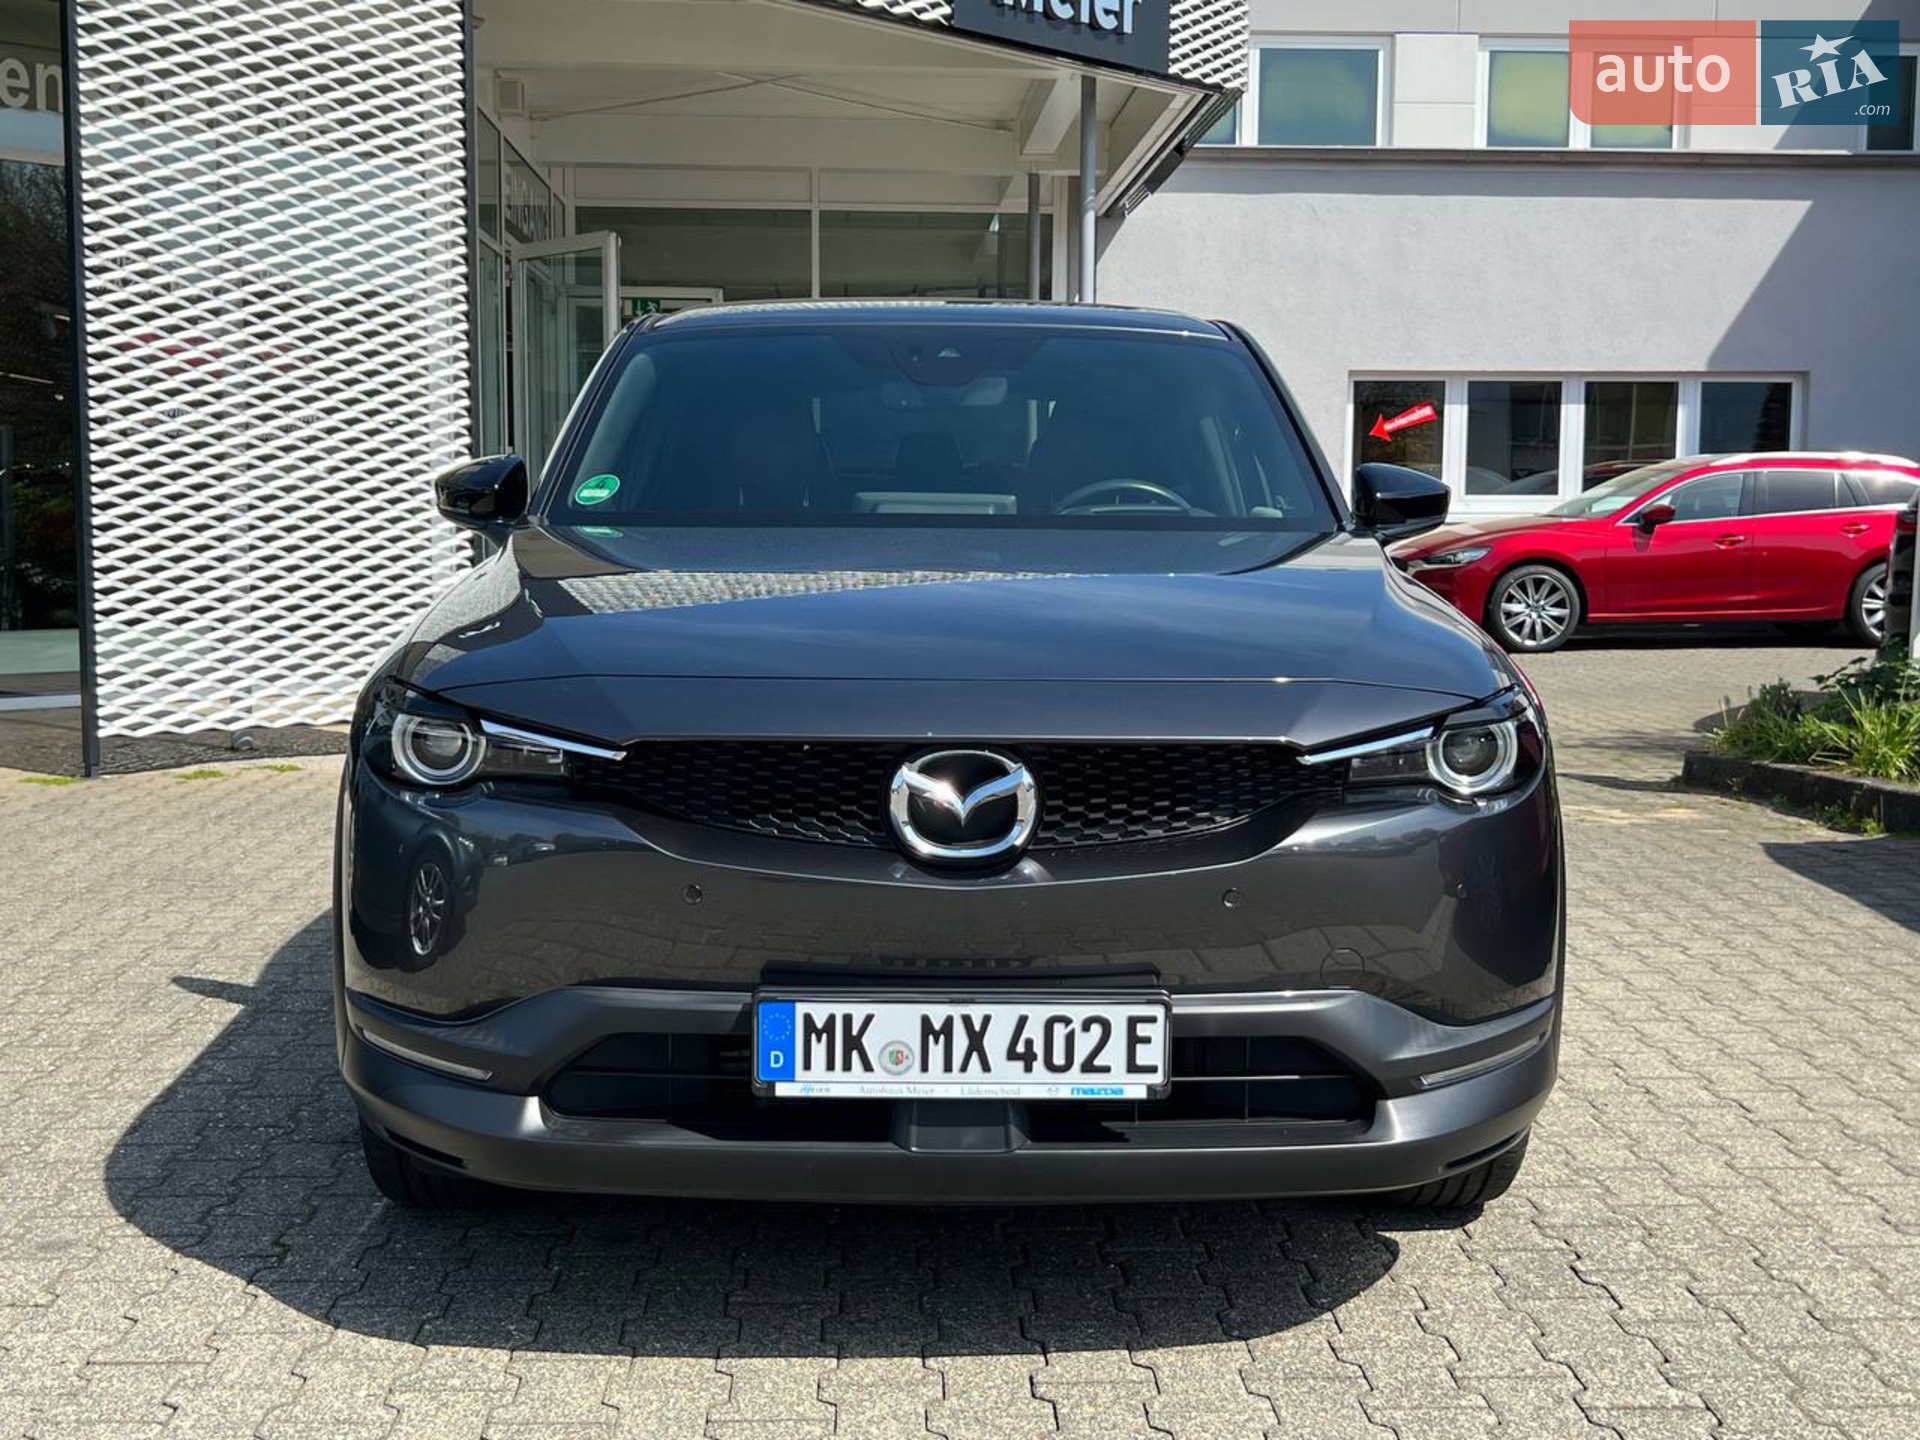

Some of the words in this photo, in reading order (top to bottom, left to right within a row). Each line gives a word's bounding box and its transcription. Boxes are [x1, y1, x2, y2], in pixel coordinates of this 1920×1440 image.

[803, 1013, 875, 1072] MK
[920, 1014, 992, 1073] MX
[771, 1051, 783, 1067] D
[1071, 1086, 1125, 1097] mazda
